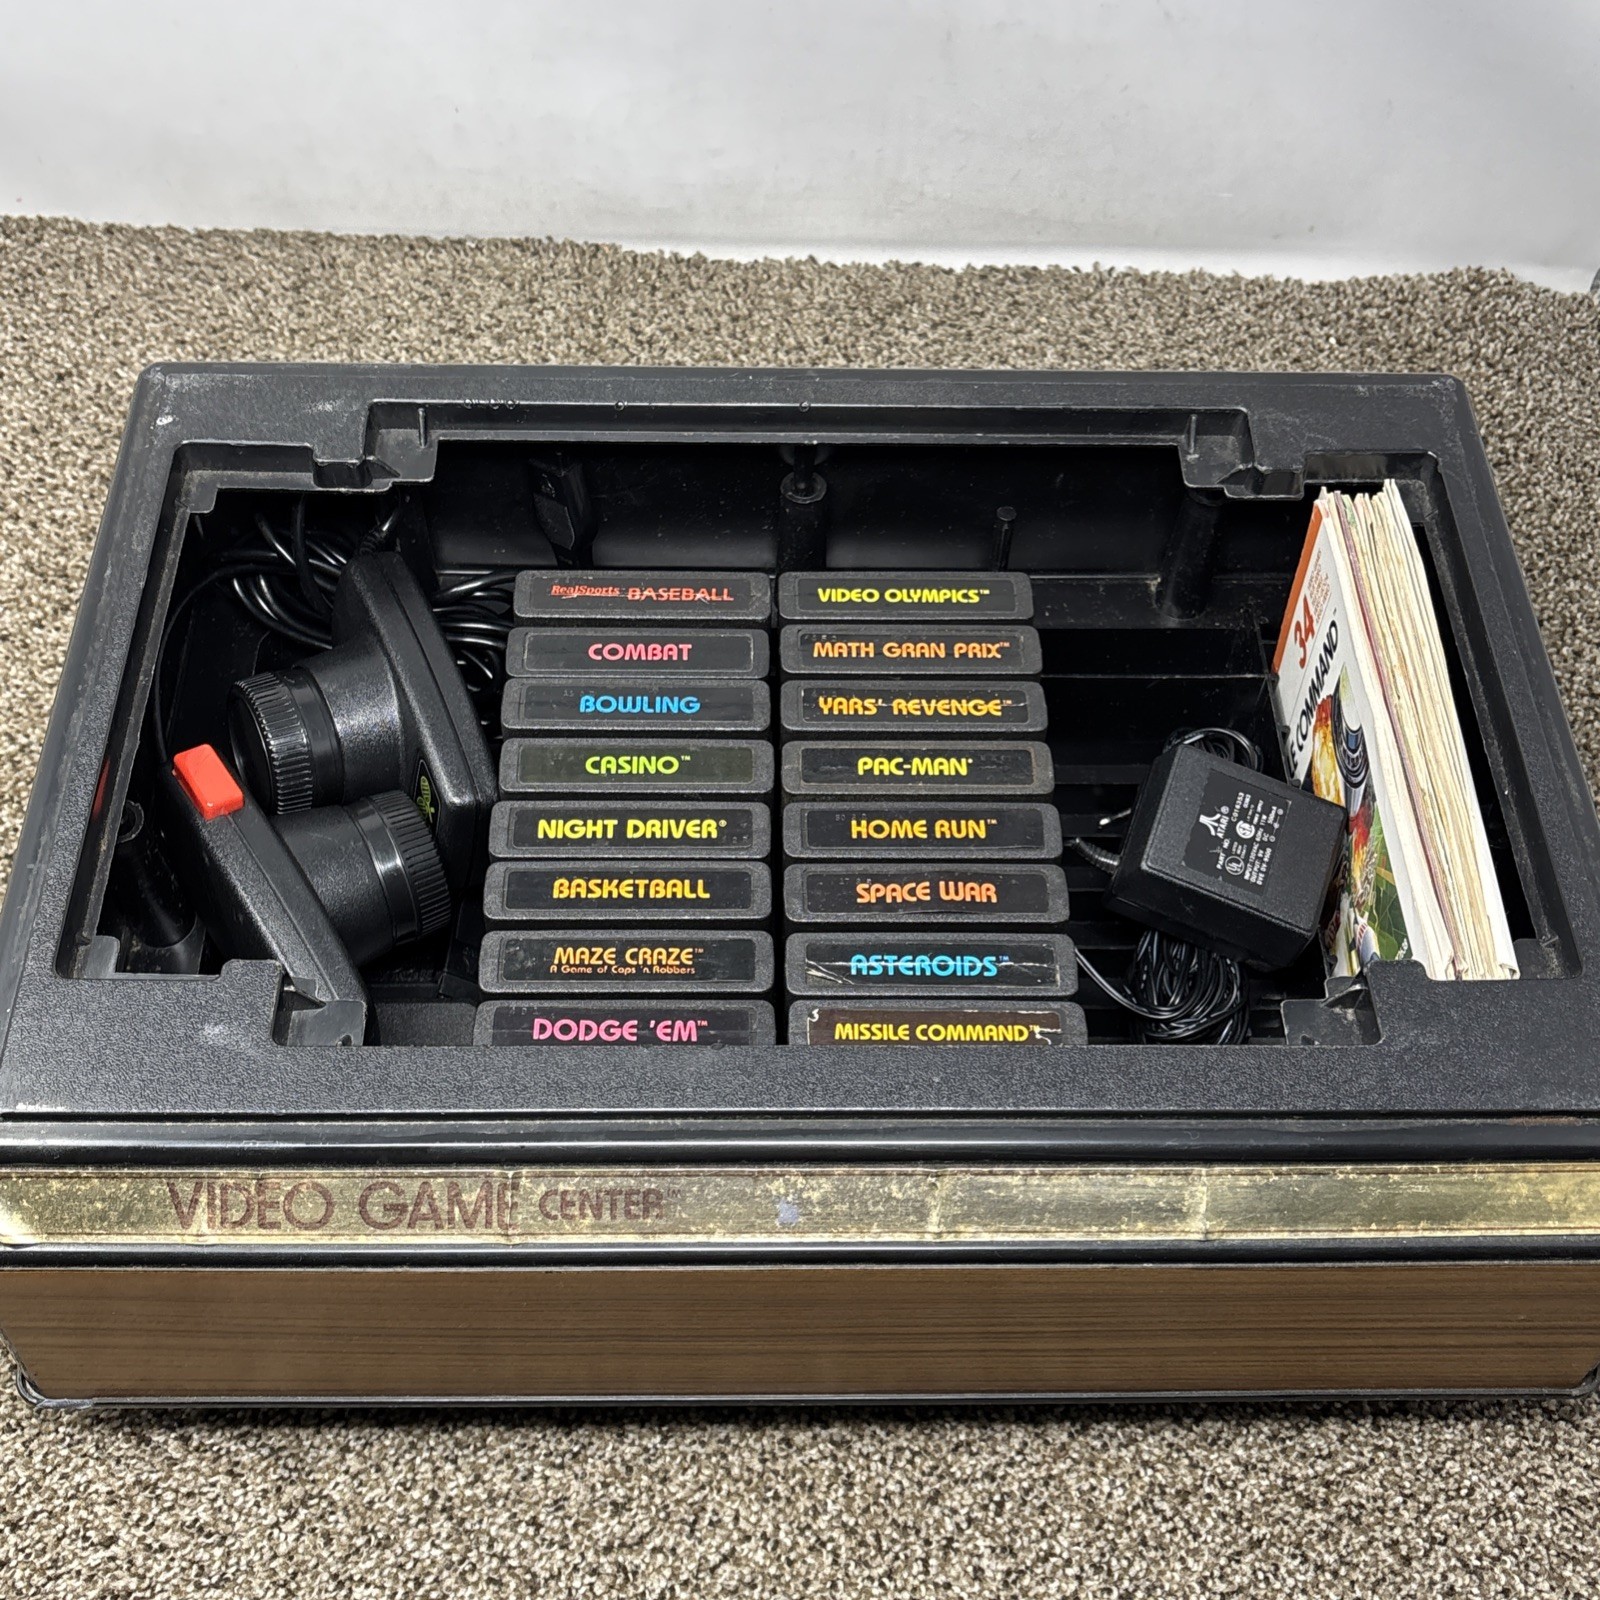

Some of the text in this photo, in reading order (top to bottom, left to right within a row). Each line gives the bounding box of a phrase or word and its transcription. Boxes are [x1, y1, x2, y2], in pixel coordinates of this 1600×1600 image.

[551, 584, 734, 602] RealSports BASEBALL
[817, 588, 881, 603] VIDEO
[1294, 594, 1316, 670] 34
[588, 643, 692, 661] COMBAT
[813, 642, 875, 658] MATH
[882, 642, 946, 659] GRAN
[1296, 620, 1339, 752] COMMAND
[579, 694, 701, 714] BOWLING
[537, 819, 617, 839] NIGHT
[851, 819, 928, 839] HOME
[1216, 851, 1227, 870] PART
[553, 879, 711, 898] BASKETBALL
[856, 881, 998, 903] SPACE WAR
[554, 947, 617, 965] MAZE
[550, 965, 557, 974] A
[561, 965, 593, 974] Game
[597, 965, 608, 974] of
[612, 965, 636, 975] Cops
[653, 965, 696, 974] Robbers
[532, 1018, 638, 1041] DODGE
[834, 1022, 910, 1041] MISSILE
[167, 1180, 335, 1231] VIDEO
[358, 1180, 520, 1231] GAME
